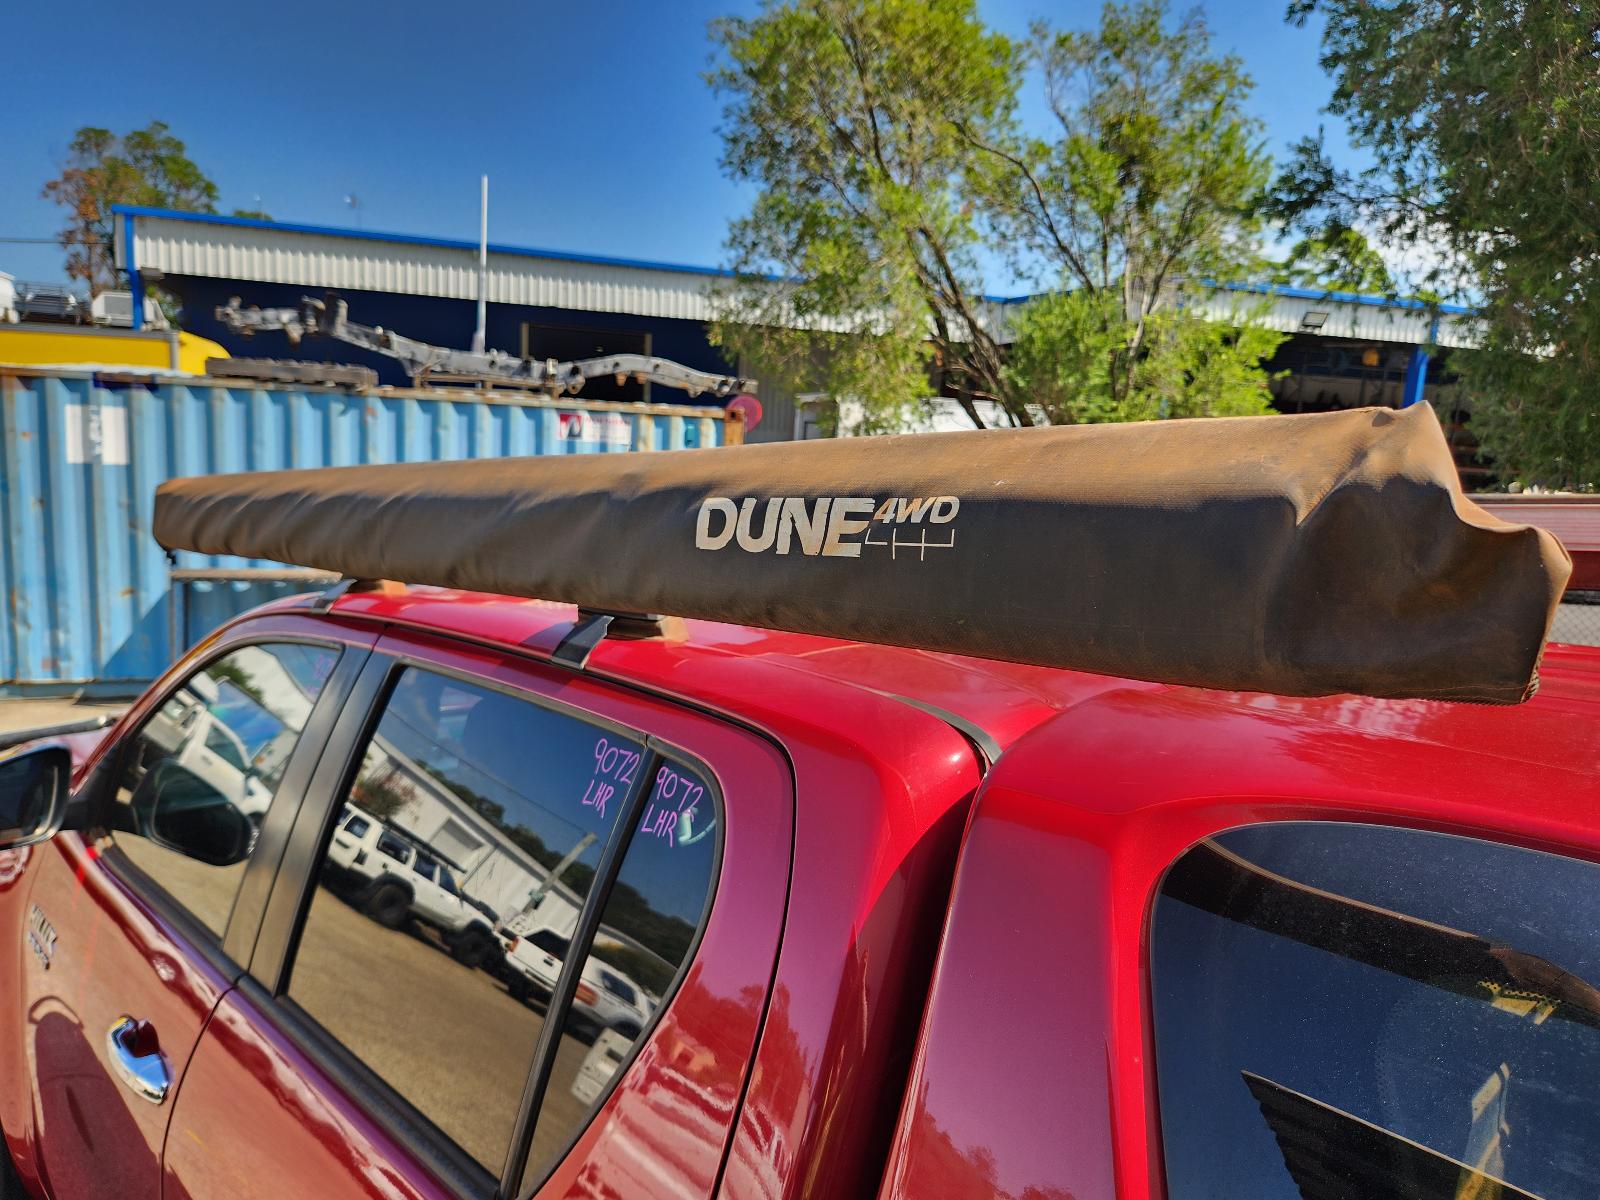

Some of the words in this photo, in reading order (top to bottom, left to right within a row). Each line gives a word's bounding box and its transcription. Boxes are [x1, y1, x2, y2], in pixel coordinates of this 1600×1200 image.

[695, 497, 876, 557] DUNE
[873, 495, 960, 524] 4WD
[594, 738, 641, 784] 9072
[582, 779, 614, 819] LHR
[656, 766, 704, 821] 9072
[641, 804, 678, 848] LHR
